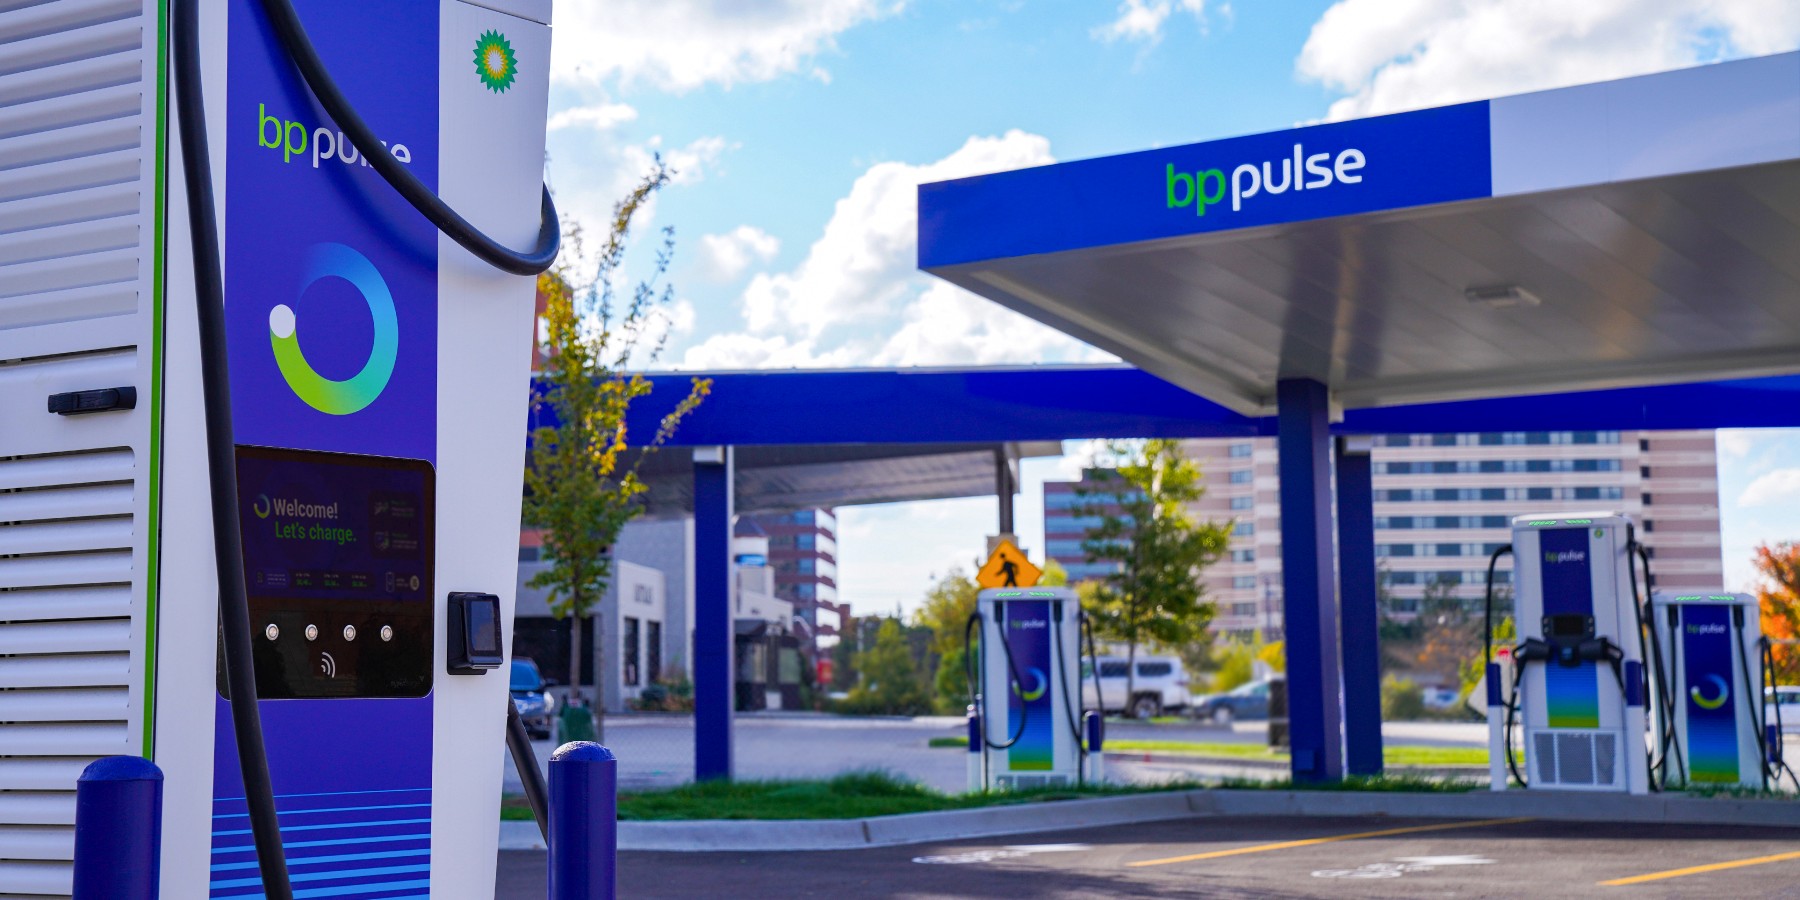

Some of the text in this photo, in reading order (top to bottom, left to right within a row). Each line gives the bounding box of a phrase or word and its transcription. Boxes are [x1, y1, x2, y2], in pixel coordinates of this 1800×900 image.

[259, 103, 411, 169] bp pue
[1166, 143, 1366, 216] bp pulse
[273, 498, 338, 520] Welcome!
[275, 521, 357, 545] Let's charge.
[1558, 549, 1585, 563] pulse
